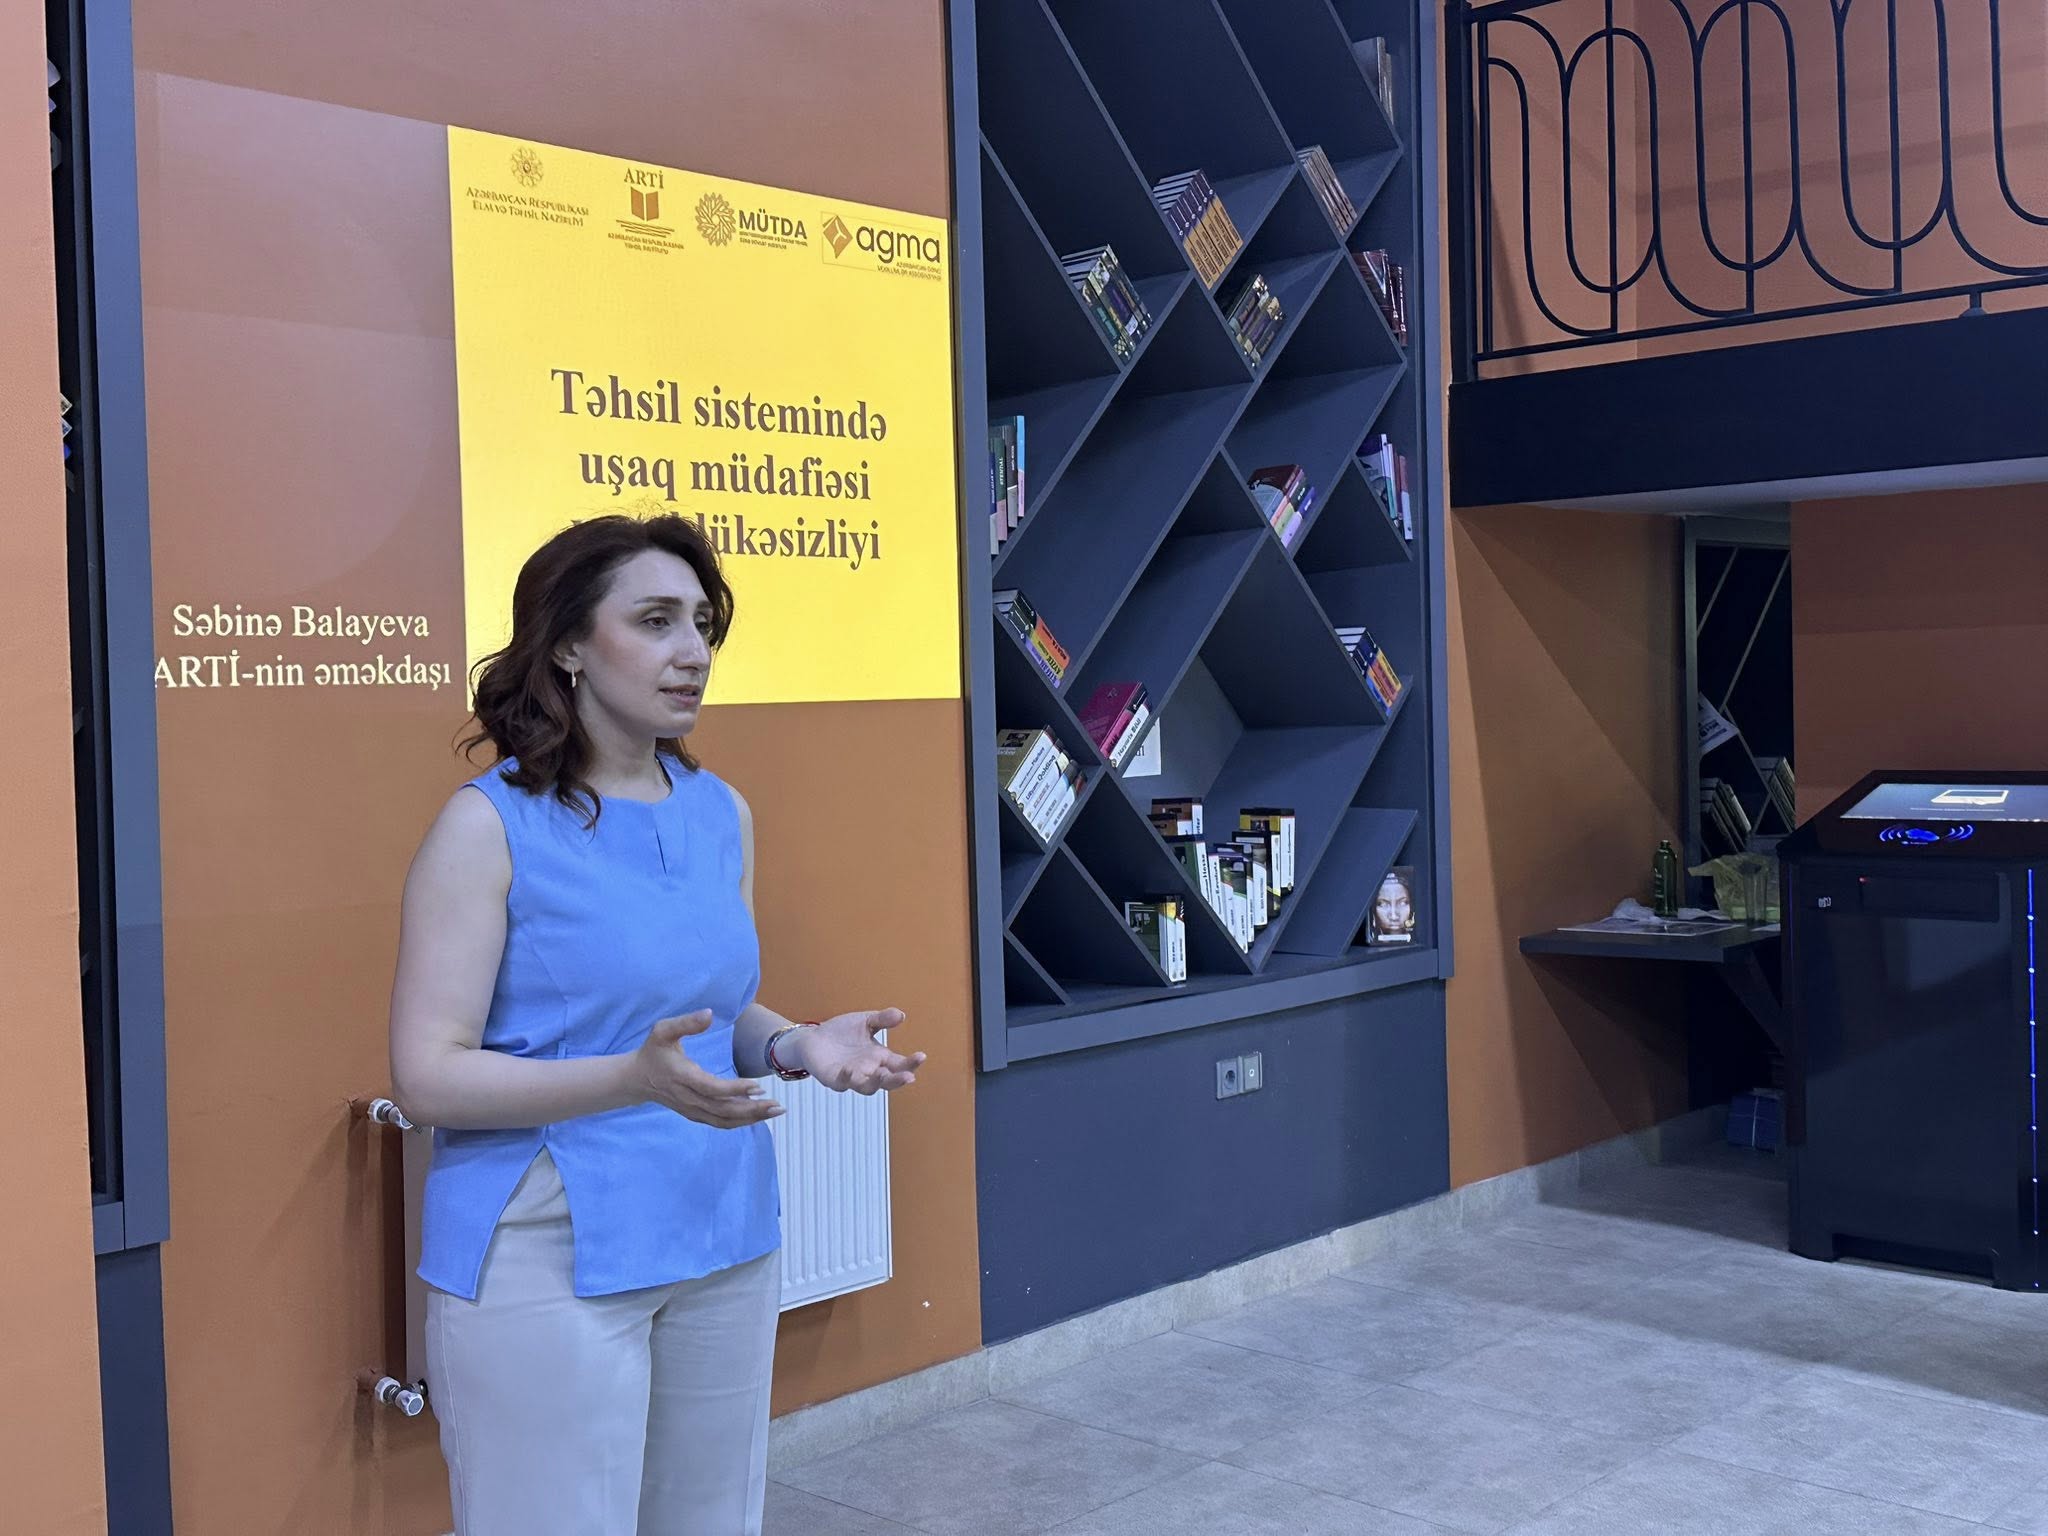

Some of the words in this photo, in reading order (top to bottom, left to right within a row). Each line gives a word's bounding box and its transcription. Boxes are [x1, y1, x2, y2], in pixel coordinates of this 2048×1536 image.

[623, 167, 664, 189] ARTİ
[738, 207, 808, 240] MÜTDA
[855, 225, 941, 264] agma
[551, 368, 682, 424] Təhsil
[694, 385, 888, 442] sistemində
[579, 452, 679, 502] uşaq
[690, 452, 872, 500] müdafiəsi
[172, 603, 283, 638] Səbinə
[291, 605, 431, 646] Balayeva
[154, 649, 305, 689] ARTİ-nin
[314, 654, 452, 691] əməkdaşı
